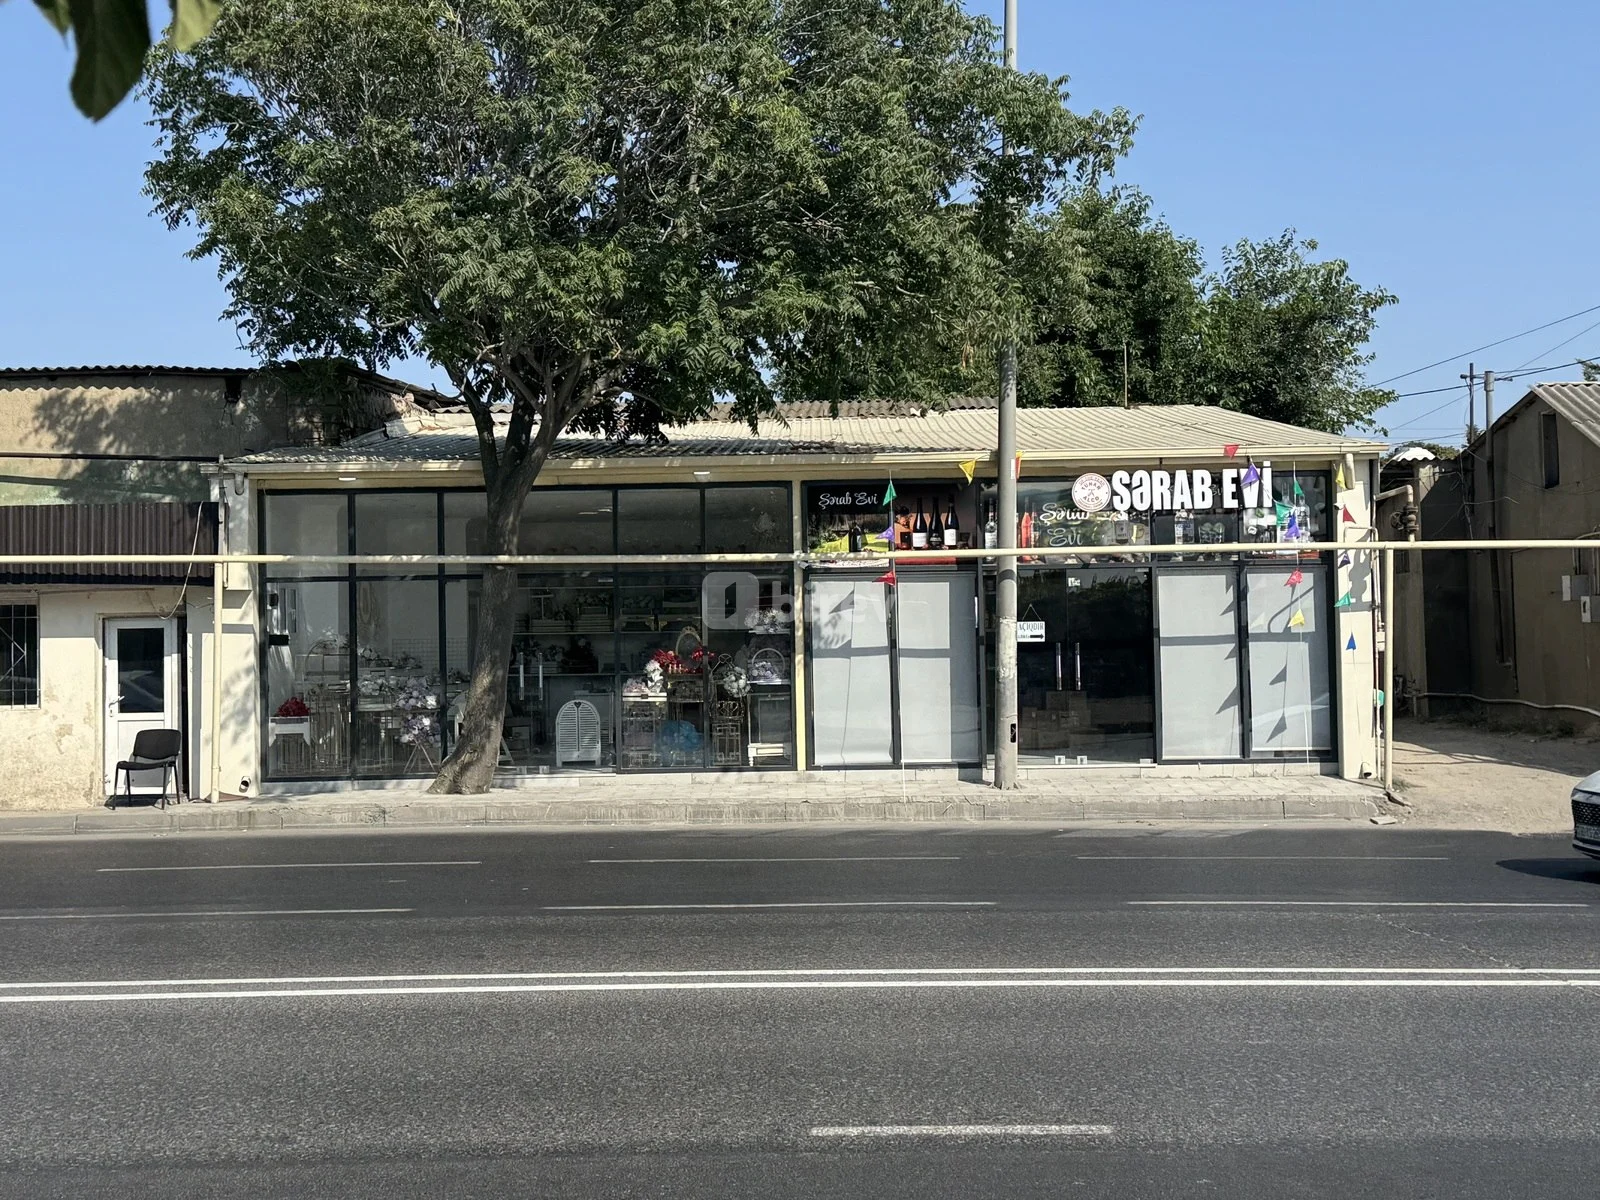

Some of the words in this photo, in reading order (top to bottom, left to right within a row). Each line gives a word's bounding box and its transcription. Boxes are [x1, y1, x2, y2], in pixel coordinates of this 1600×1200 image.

[1222, 461, 1273, 508] EVİ
[818, 492, 852, 509] Şərab
[854, 491, 878, 507] Evi
[1047, 527, 1083, 547] Evi
